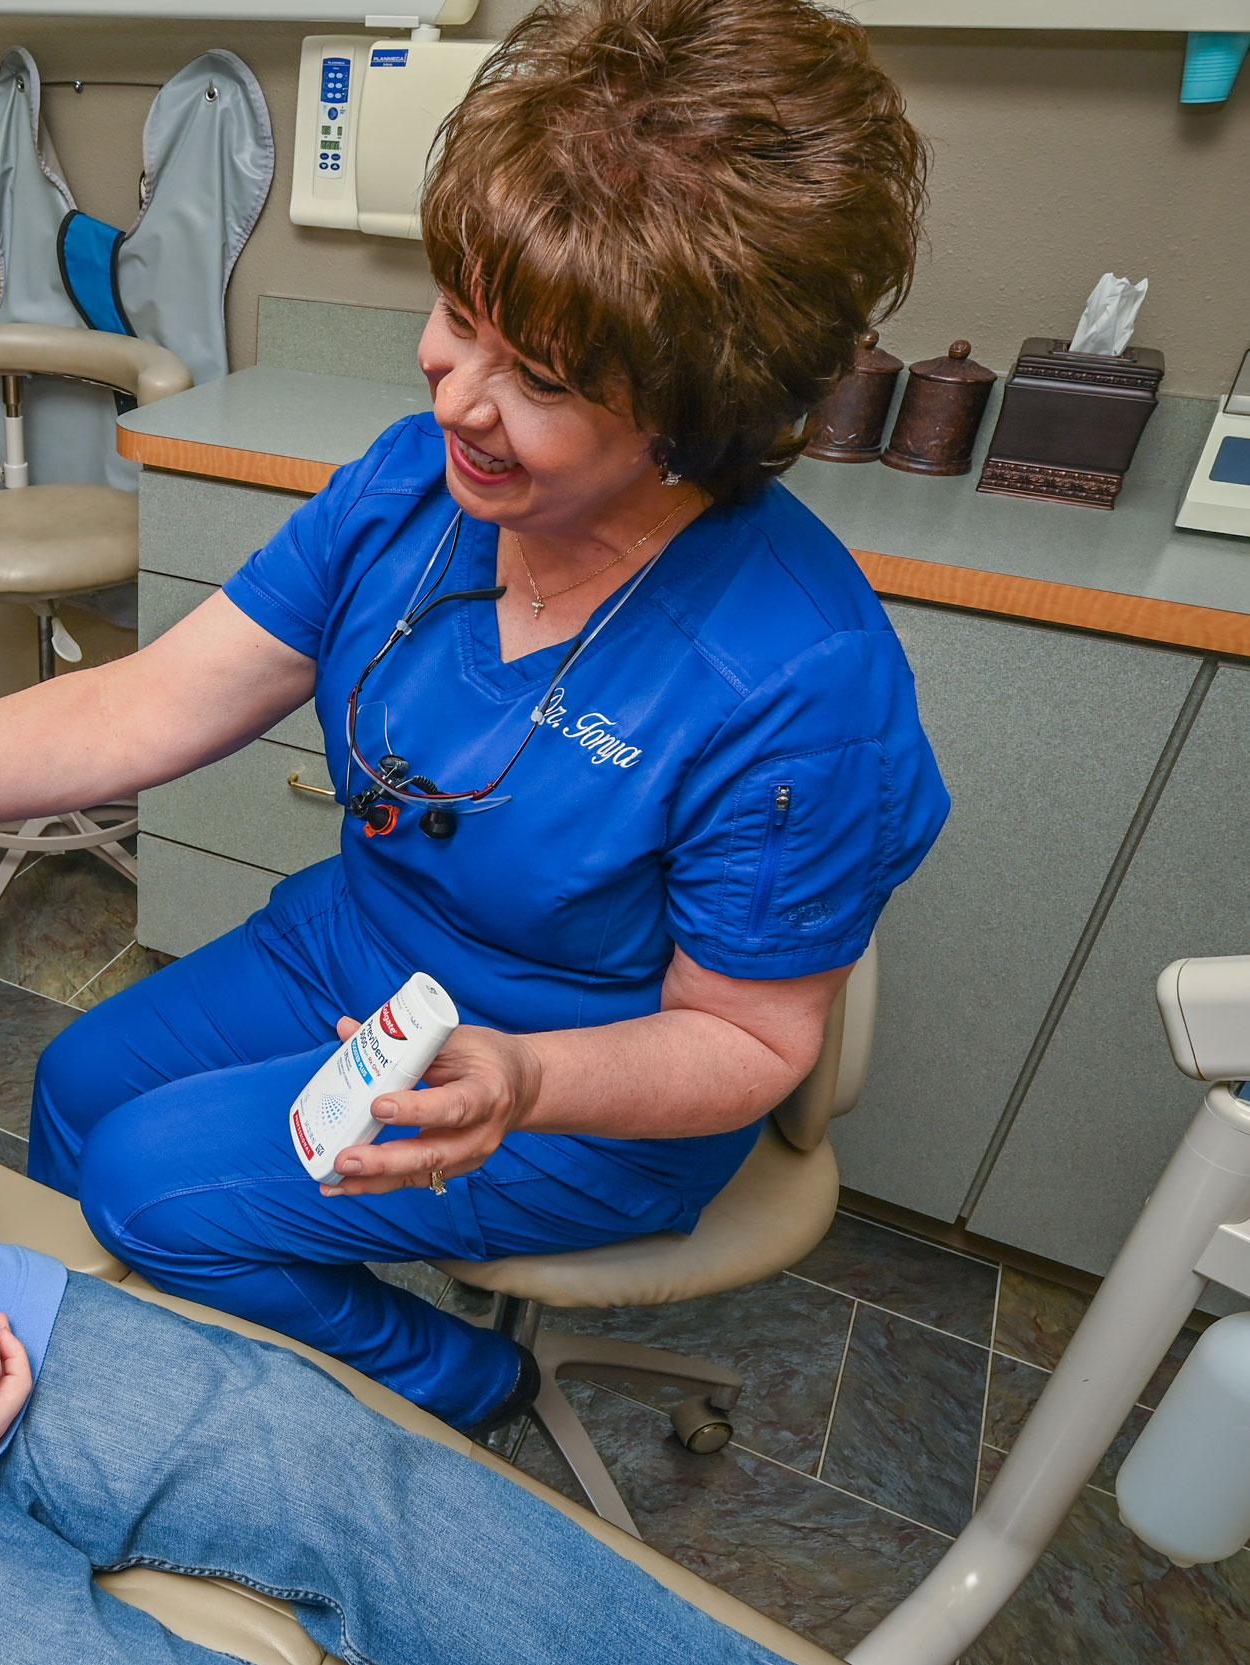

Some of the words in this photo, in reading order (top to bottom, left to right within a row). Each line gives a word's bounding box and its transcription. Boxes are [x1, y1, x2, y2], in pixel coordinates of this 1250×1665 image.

[562, 712, 643, 768] Tonya
[366, 1019, 390, 1068] PreviDent
[358, 1061, 368, 1077] PLUS
[372, 1063, 381, 1077] Only
[295, 1114, 311, 1154] PROFESSIONAL
